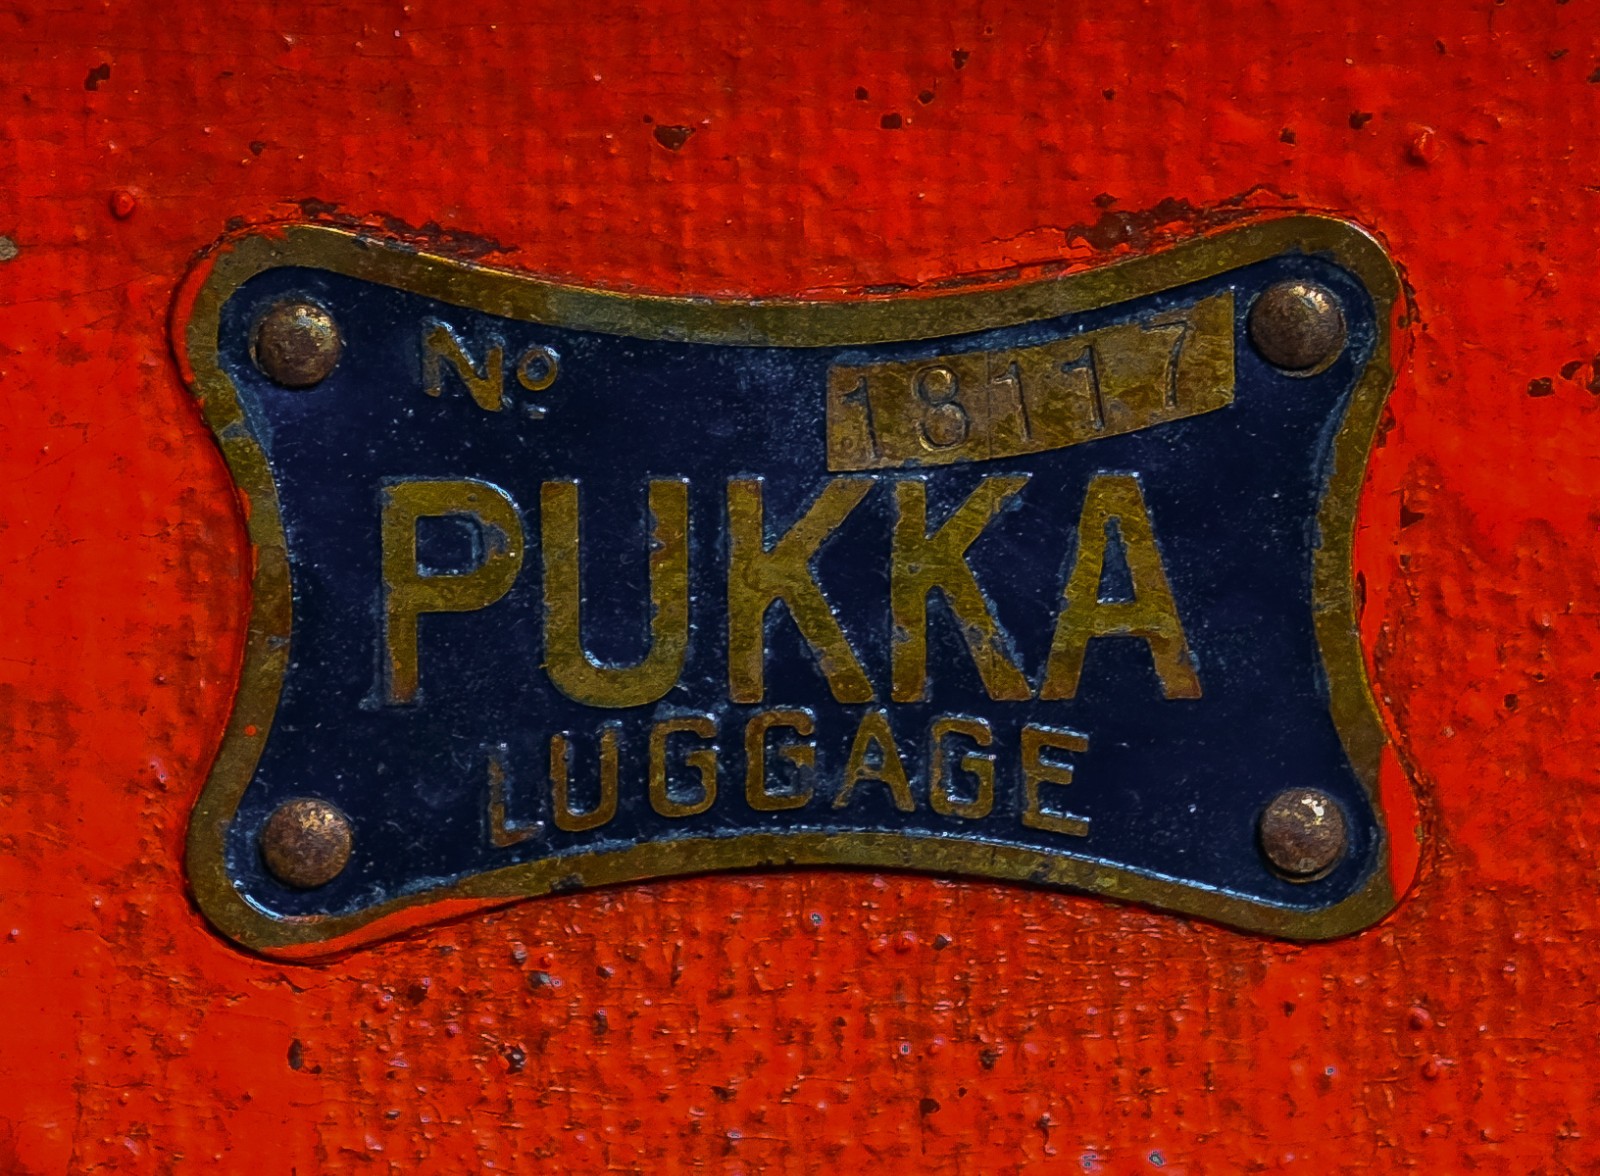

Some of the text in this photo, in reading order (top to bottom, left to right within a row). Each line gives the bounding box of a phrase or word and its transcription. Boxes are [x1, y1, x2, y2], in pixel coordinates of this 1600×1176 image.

[841, 316, 1196, 463] 18117
[381, 474, 1202, 708] PUKKA
[488, 708, 1092, 848] LUGGAGE
